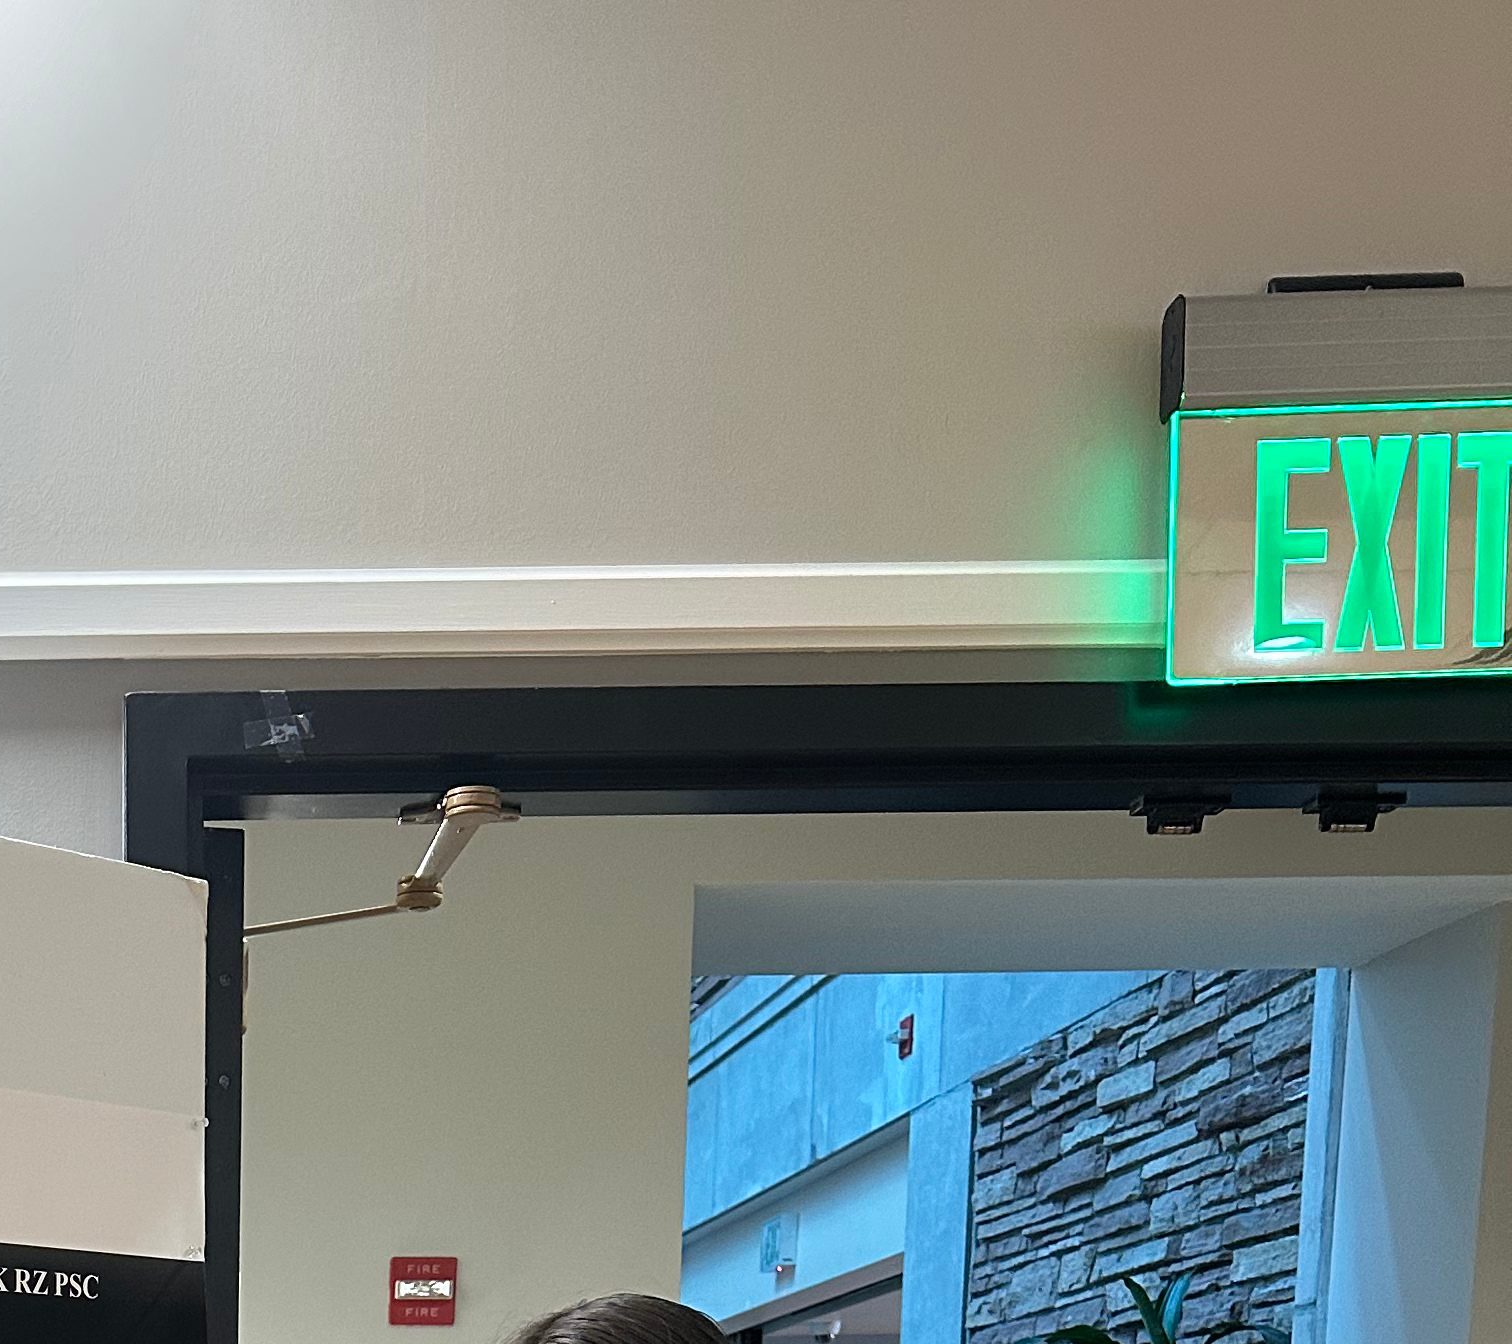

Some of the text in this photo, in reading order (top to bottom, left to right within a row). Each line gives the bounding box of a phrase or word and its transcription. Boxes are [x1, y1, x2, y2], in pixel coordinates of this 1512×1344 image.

[1253, 431, 1512, 654] EXIT
[406, 1264, 441, 1275] FIRE
[13, 1268, 48, 1295] RZ
[53, 1272, 98, 1299] PSC
[404, 1307, 439, 1317] FIRE
